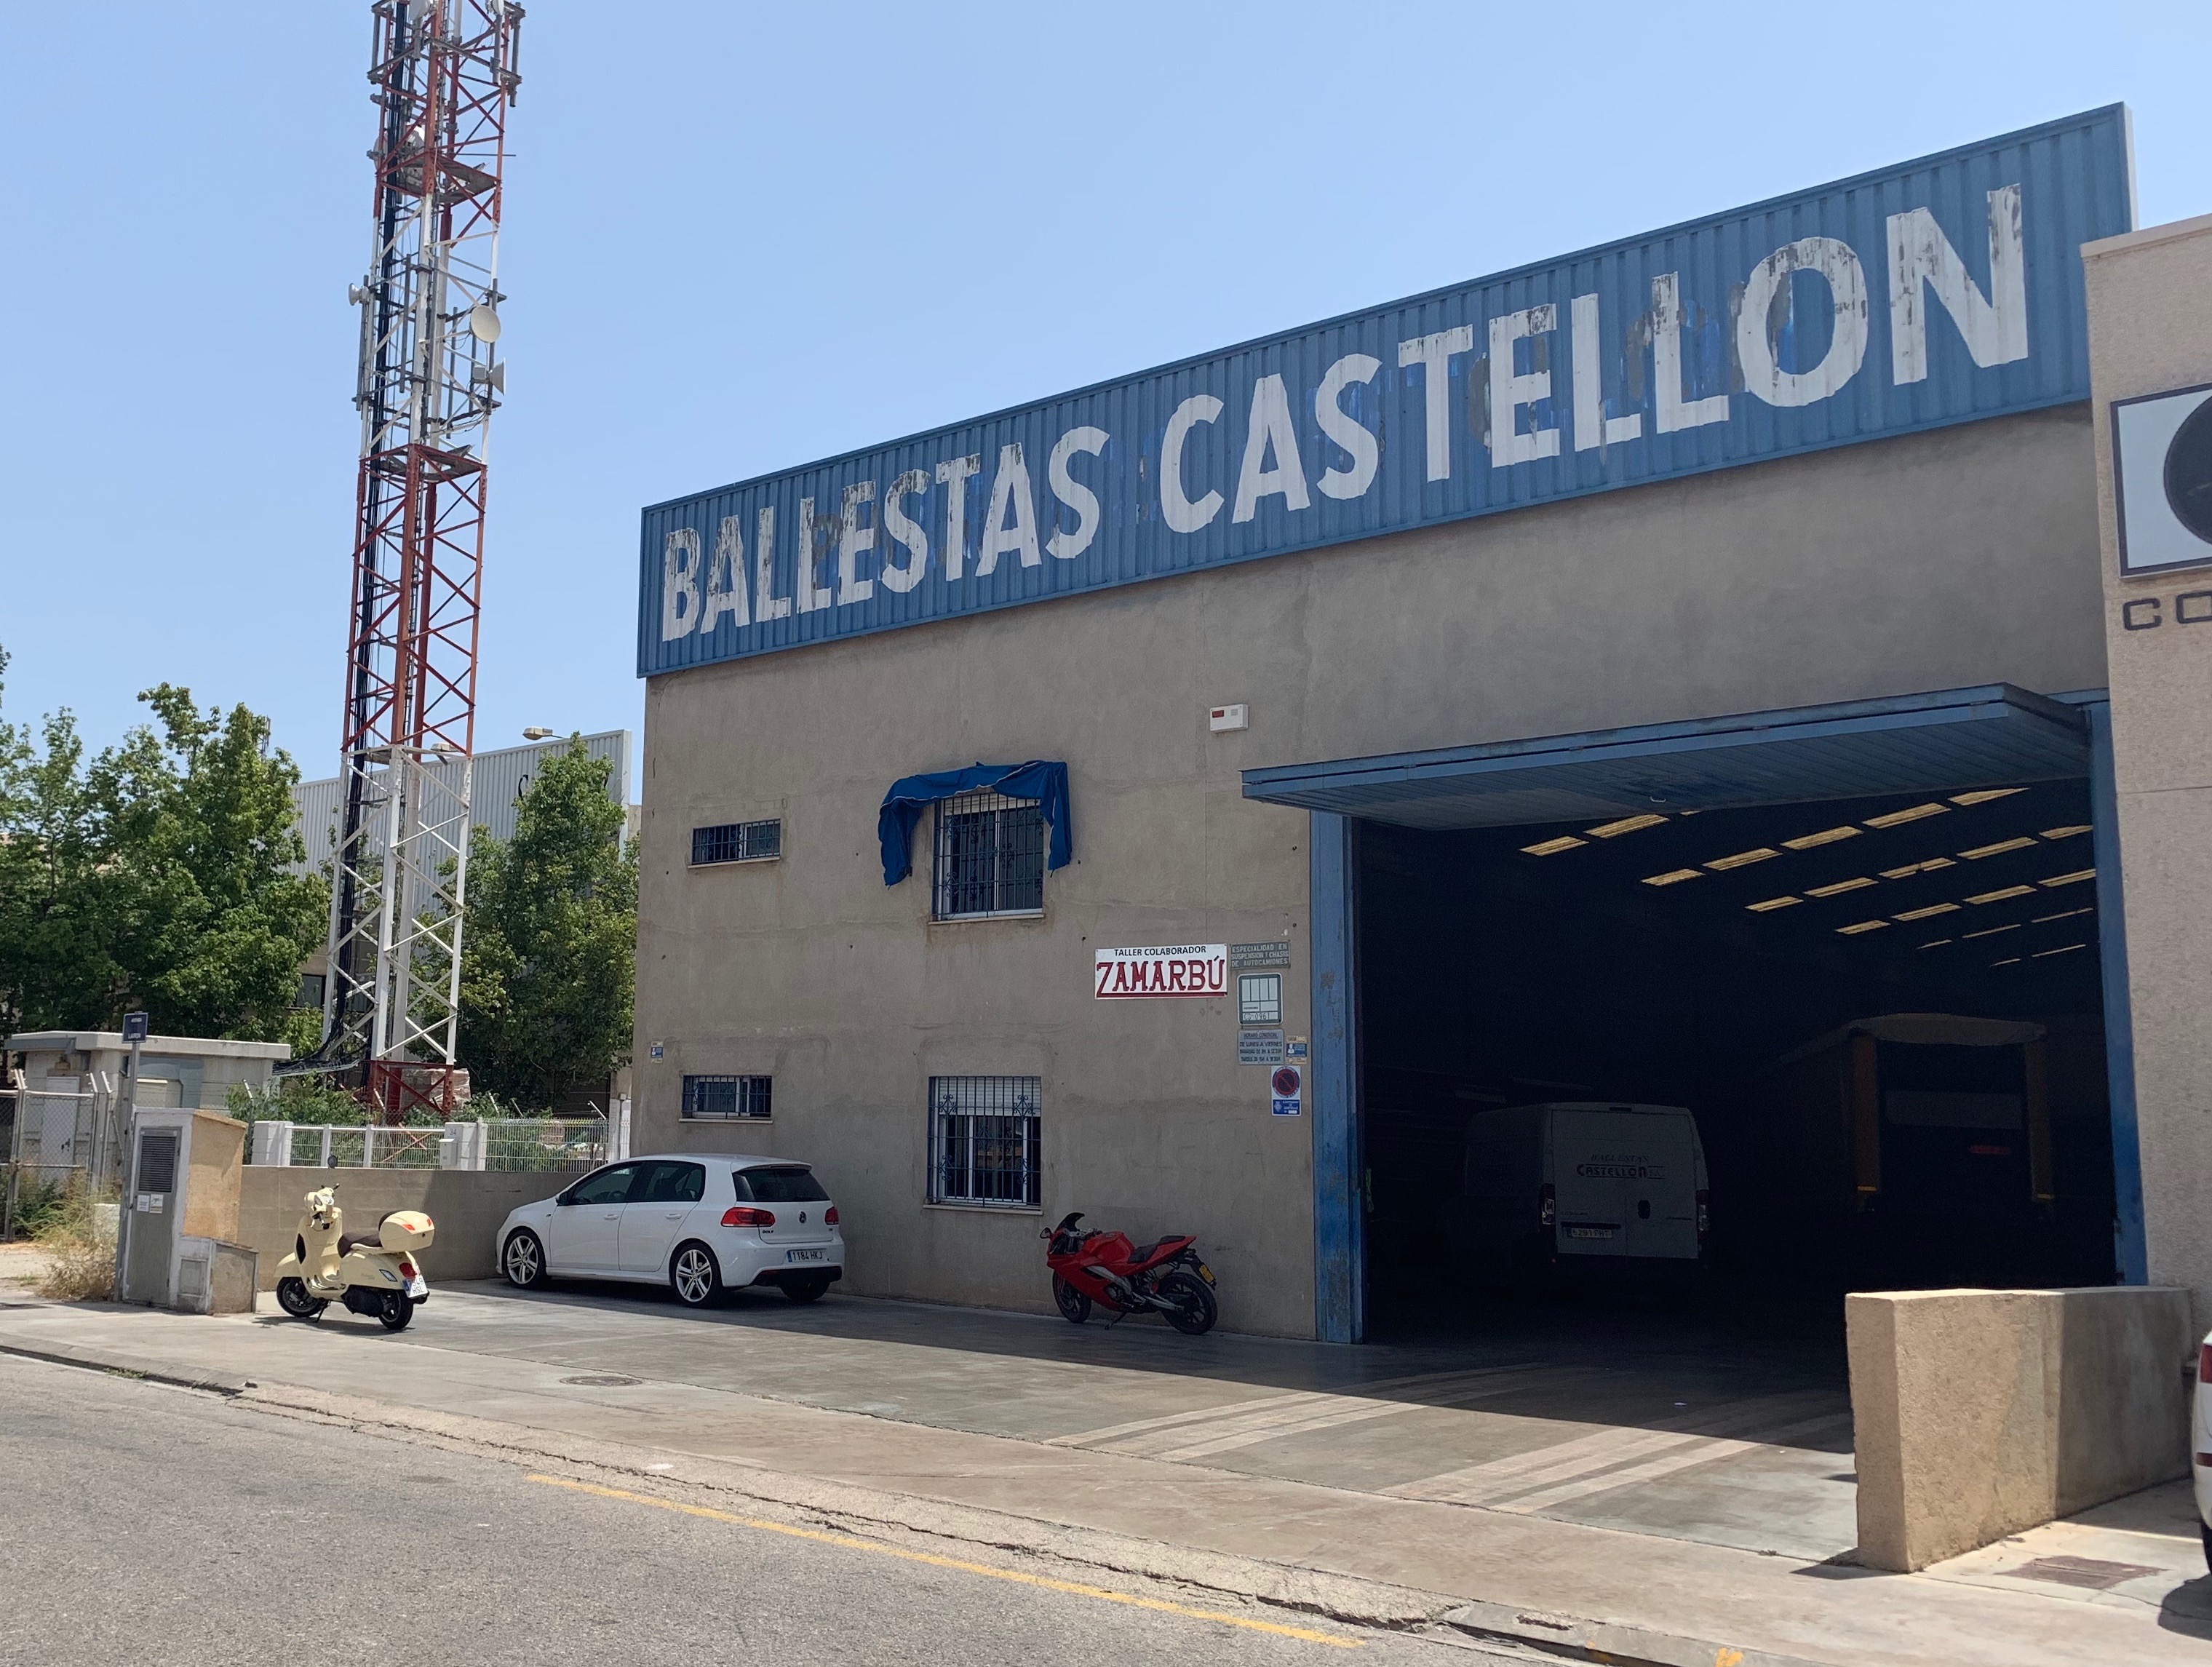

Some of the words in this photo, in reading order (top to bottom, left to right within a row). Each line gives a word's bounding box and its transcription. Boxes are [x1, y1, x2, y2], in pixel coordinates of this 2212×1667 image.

[662, 426, 1110, 642] BALLESTAS
[1160, 183, 2029, 533] CASTELLON
[1145, 945, 1206, 956] COLABORADOR
[1232, 944, 1274, 953] ESPECIALIDAD
[1244, 958, 1288, 966] AUTOCAMIONES
[1097, 955, 1225, 998] ZAMARBÚ
[792, 1252, 809, 1260] 1184
[811, 1252, 823, 1260] HKJ
[412, 1286, 424, 1294] HSL
